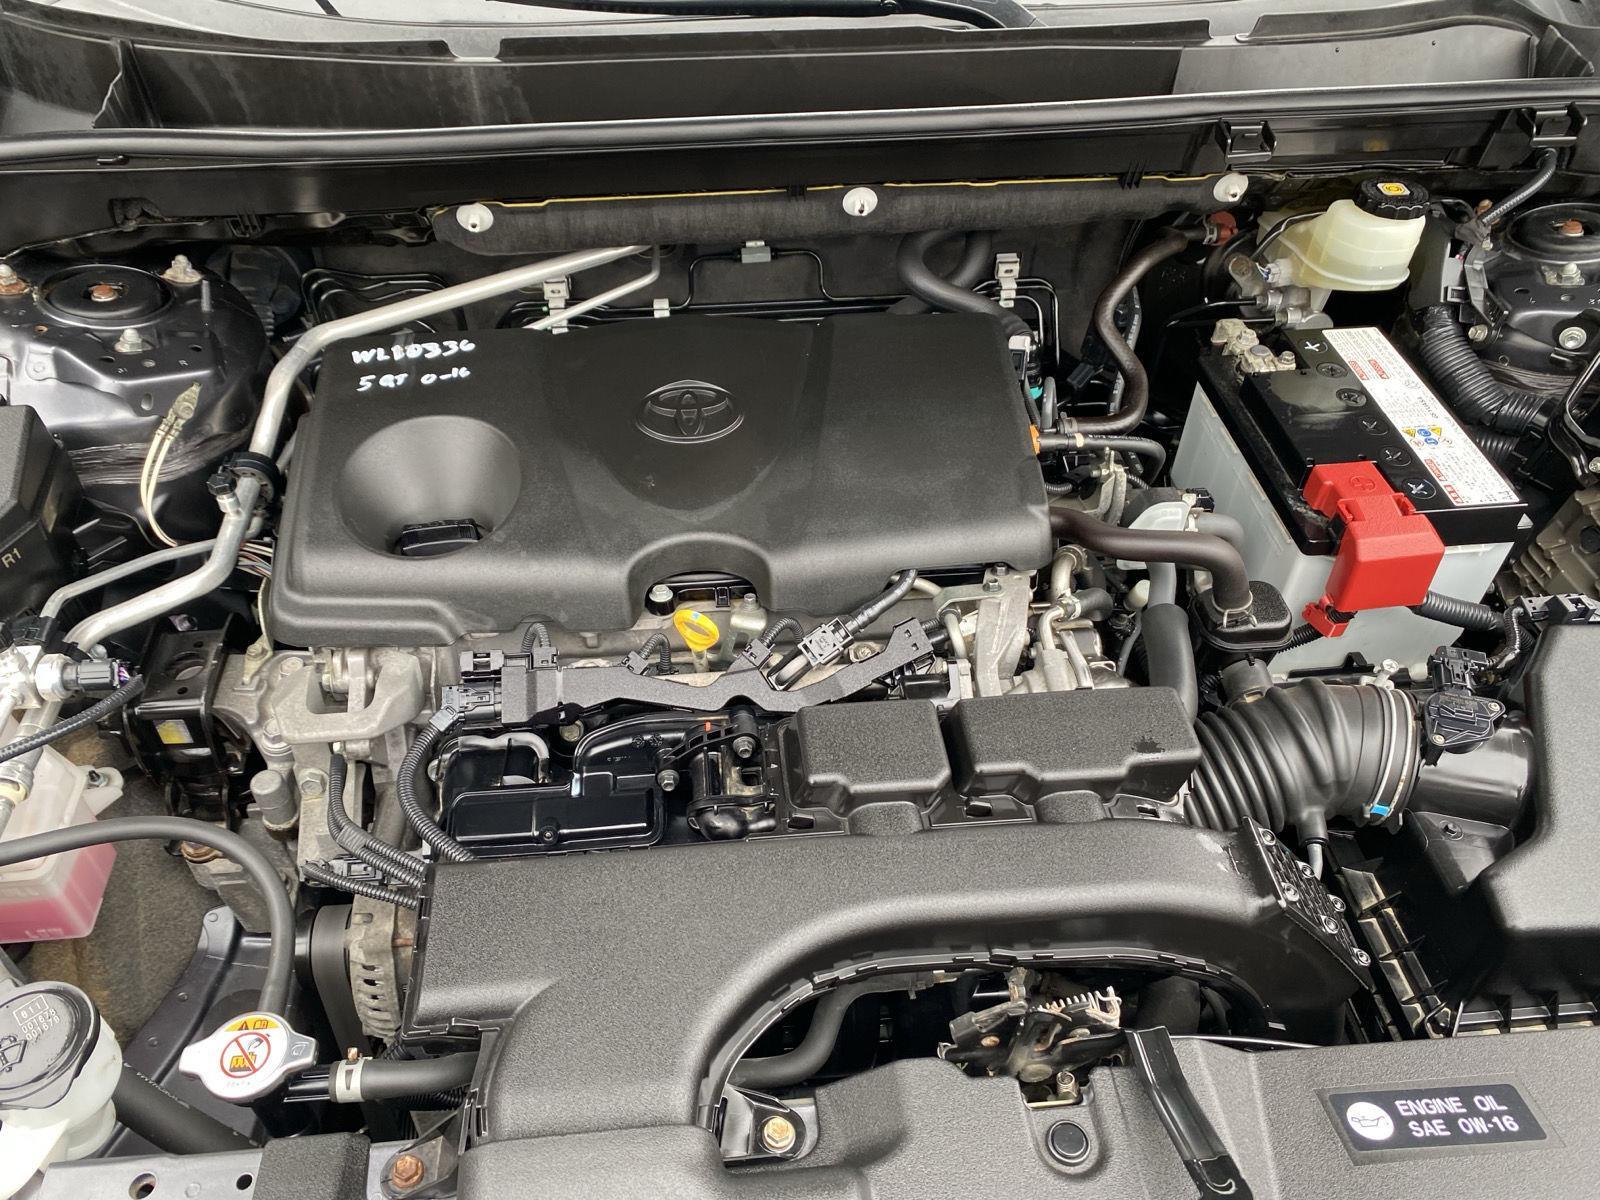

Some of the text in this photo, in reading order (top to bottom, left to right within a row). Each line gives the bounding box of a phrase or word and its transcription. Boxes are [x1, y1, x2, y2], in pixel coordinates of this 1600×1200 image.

[355, 374, 377, 392] 5
[1, 547, 22, 569] R1
[1394, 1094, 1508, 1117] ENGINE OIL
[1408, 1114, 1520, 1138] SAE 0W-16
